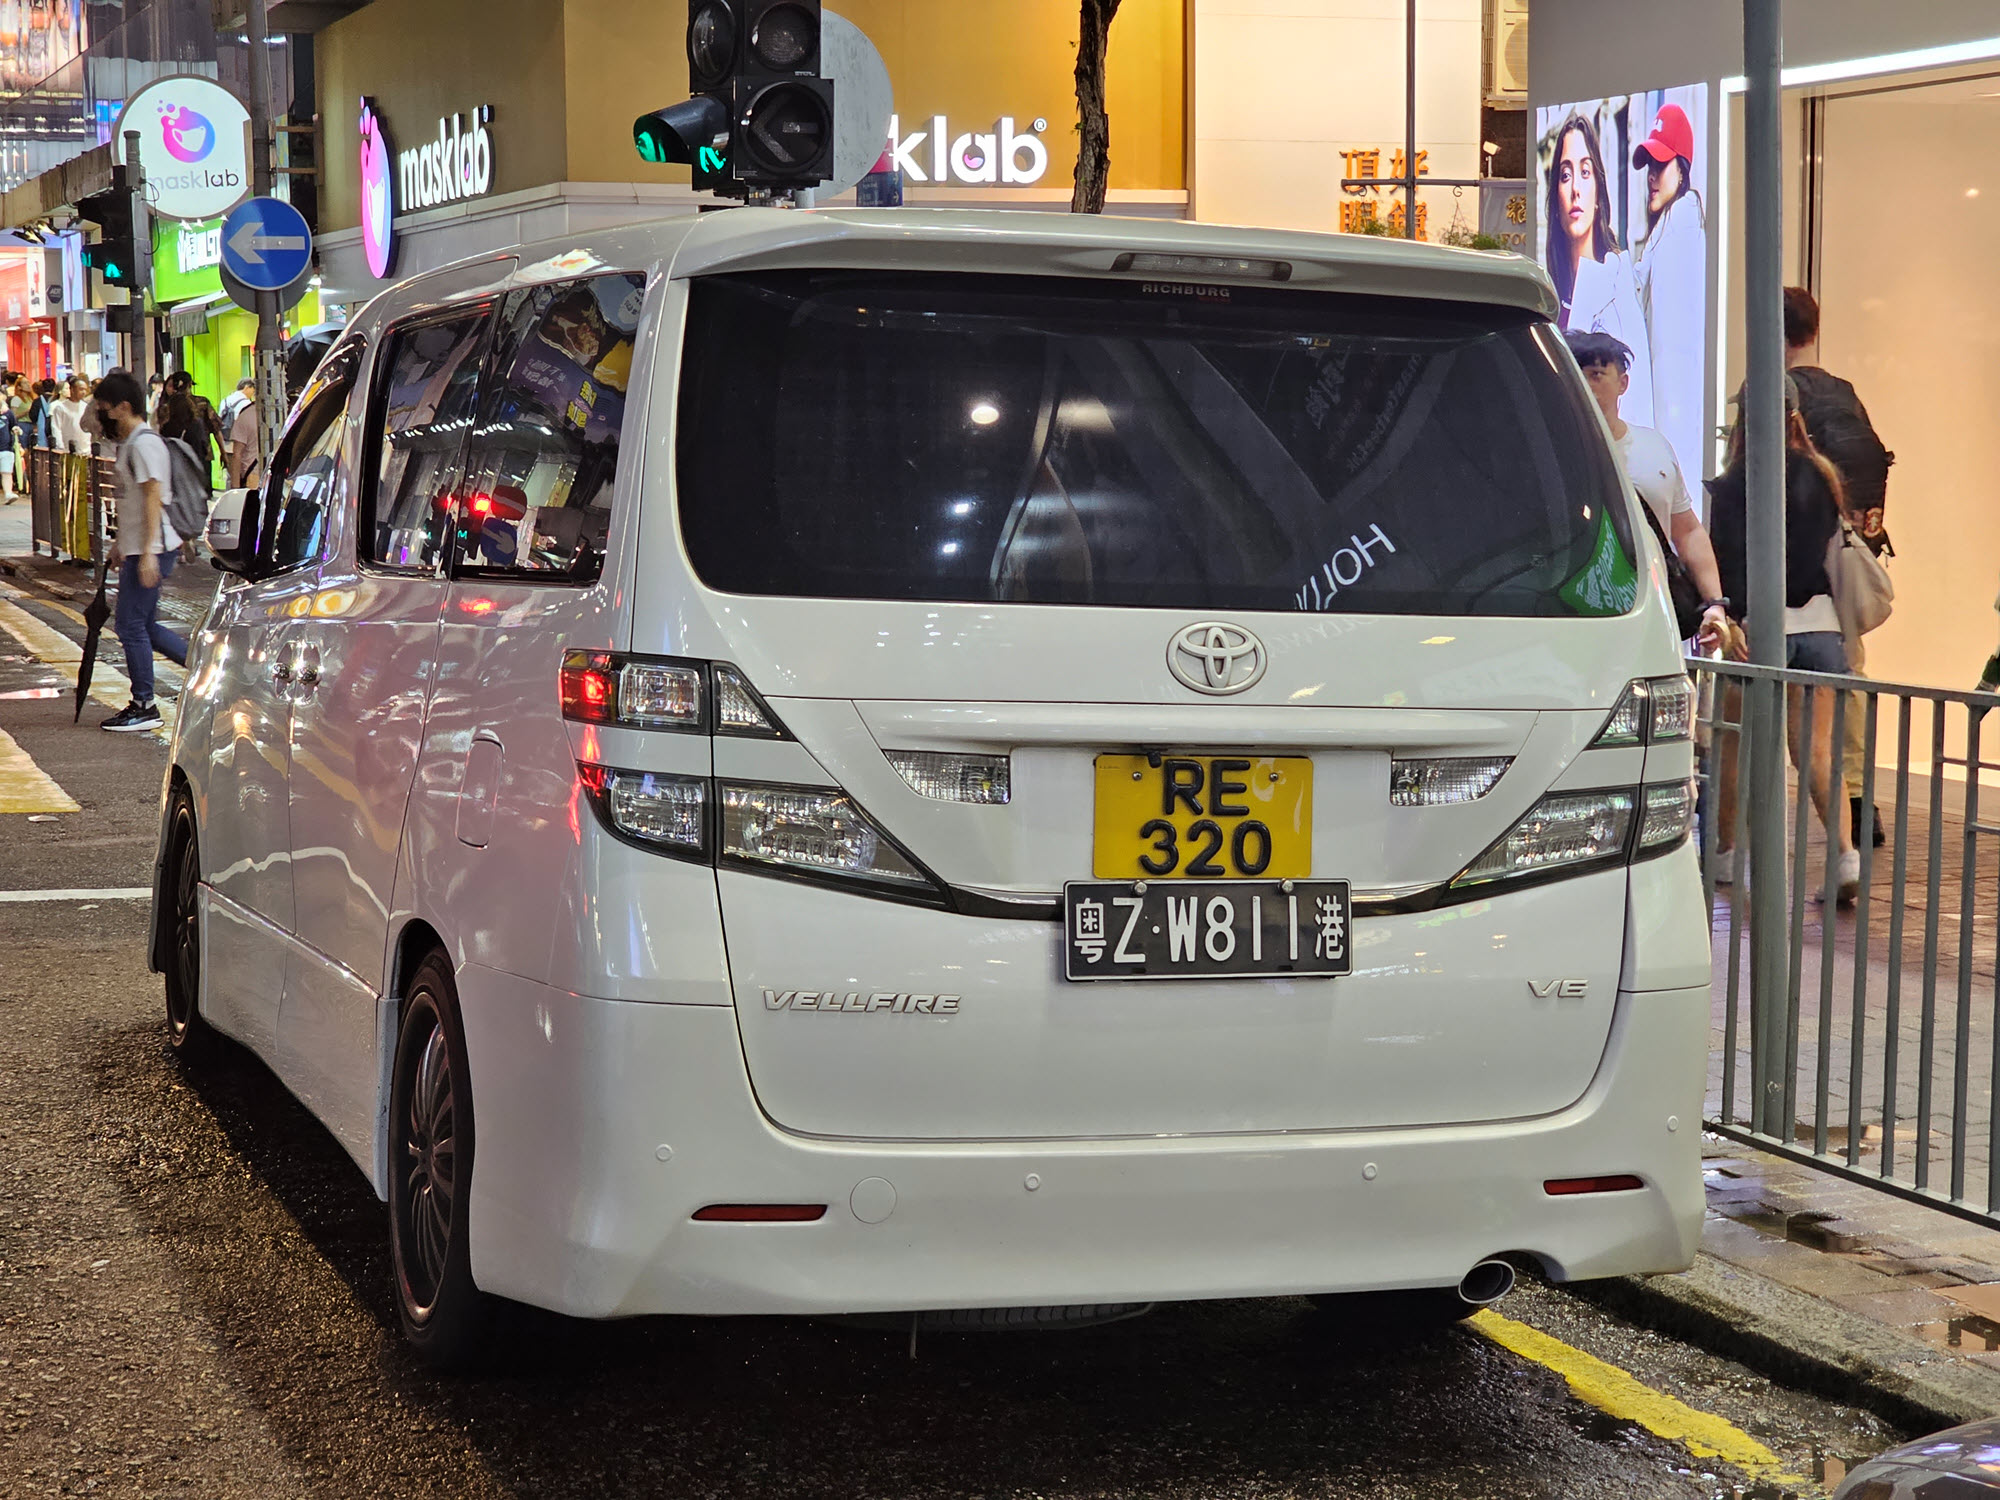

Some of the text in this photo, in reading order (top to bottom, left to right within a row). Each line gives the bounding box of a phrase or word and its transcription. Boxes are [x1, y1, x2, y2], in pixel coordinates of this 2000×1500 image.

[400, 106, 491, 211] masklab
[1142, 283, 1231, 298] RICHBURG
[1163, 758, 1251, 816] RE
[1138, 818, 1273, 877] 320
[763, 989, 962, 1015] VELLFIRE
